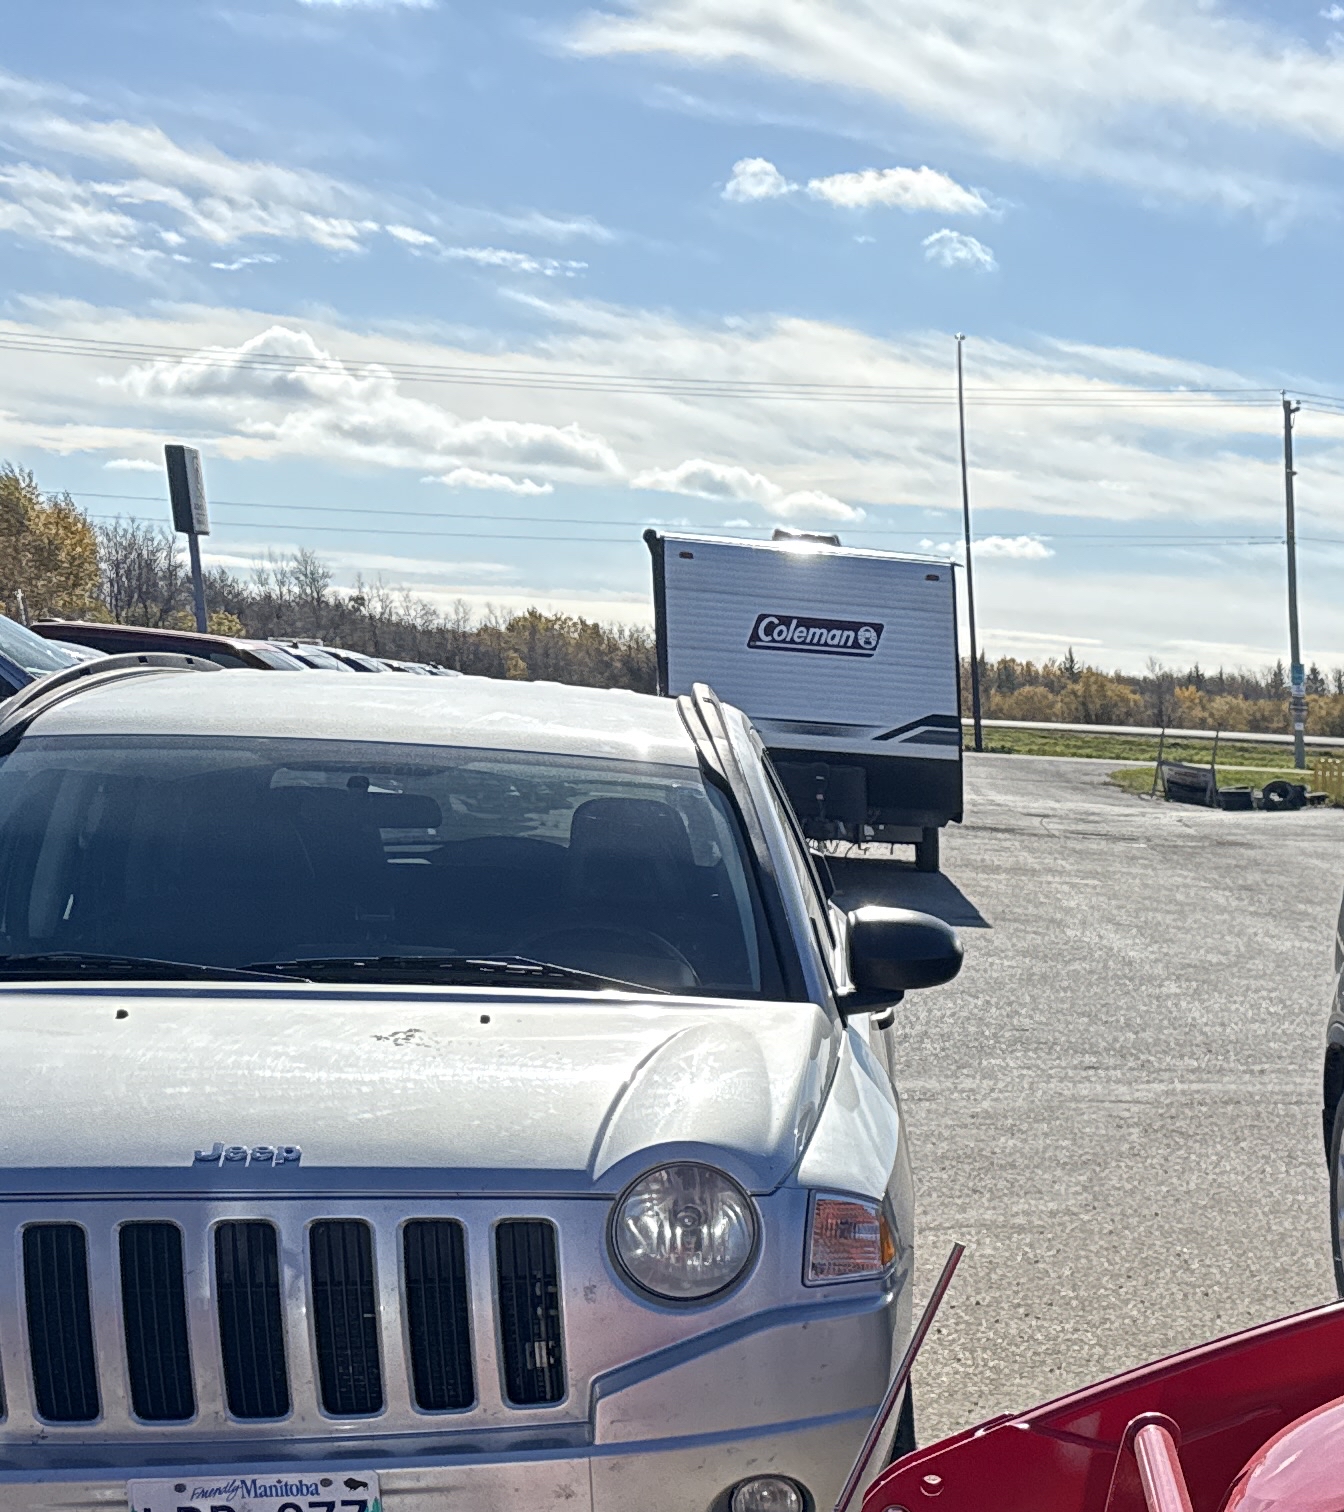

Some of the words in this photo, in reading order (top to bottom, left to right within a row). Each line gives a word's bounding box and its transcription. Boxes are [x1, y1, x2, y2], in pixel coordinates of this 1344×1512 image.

[757, 616, 855, 647] Coleman
[193, 1140, 304, 1168] Jeep
[240, 1478, 320, 1497] Manitoba
